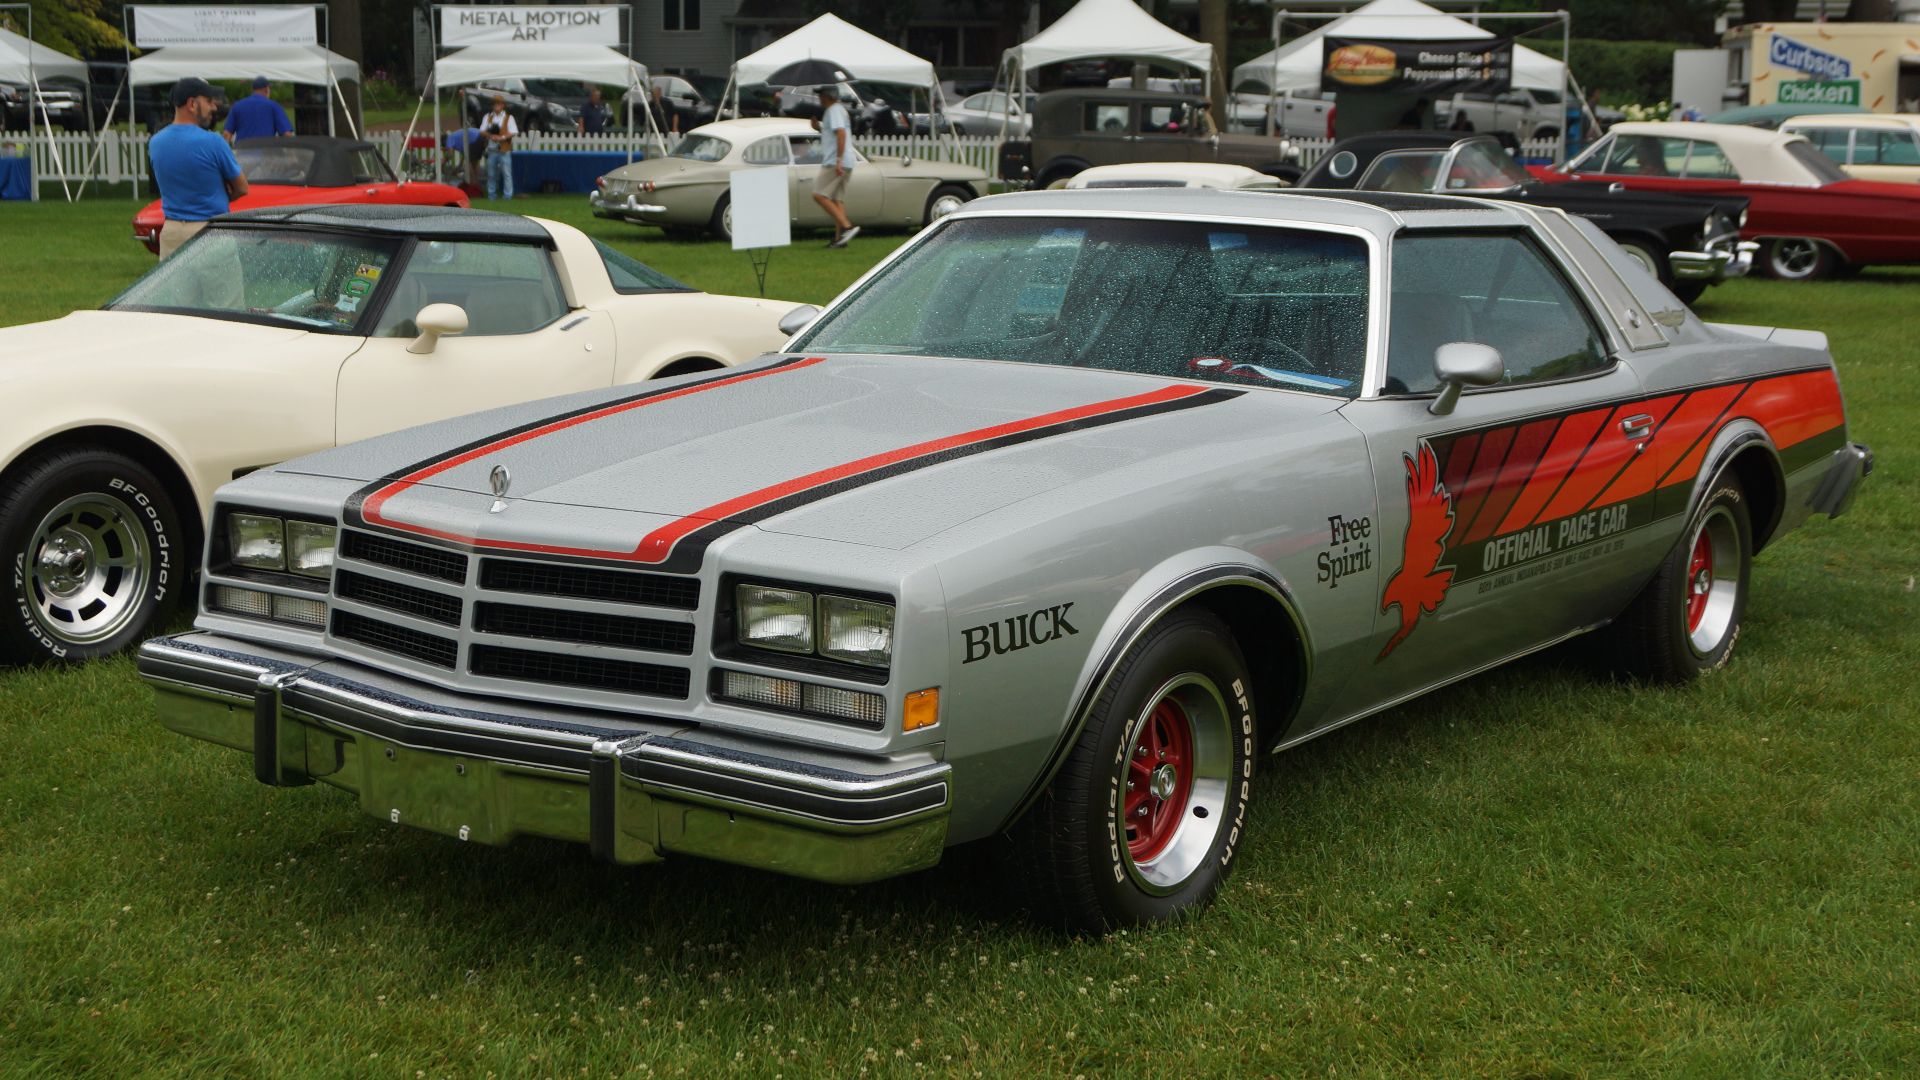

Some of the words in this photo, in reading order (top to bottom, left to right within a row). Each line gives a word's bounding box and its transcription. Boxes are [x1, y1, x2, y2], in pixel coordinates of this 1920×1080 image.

[460, 11, 520, 25] METAL
[526, 11, 600, 25] MOTION
[511, 26, 548, 41] ART
[1418, 51, 1455, 64] Cheese
[1772, 39, 1847, 79] Curbside
[1781, 82, 1853, 102] Chicken
[108, 477, 171, 602] BFGoodrich
[1327, 514, 1371, 546] Free
[1482, 526, 1552, 572] OFFICIAL
[1557, 511, 1597, 549] PACE
[1599, 503, 1628, 536] CAR
[14, 552, 25, 588] T/A
[1317, 541, 1372, 589] Spirit
[16, 597, 68, 658] Radial
[961, 602, 1079, 664] BUICK
[1115, 718, 1135, 765] T/A
[1220, 677, 1253, 866] BFGoodrich
[1108, 776, 1125, 883] Radial
